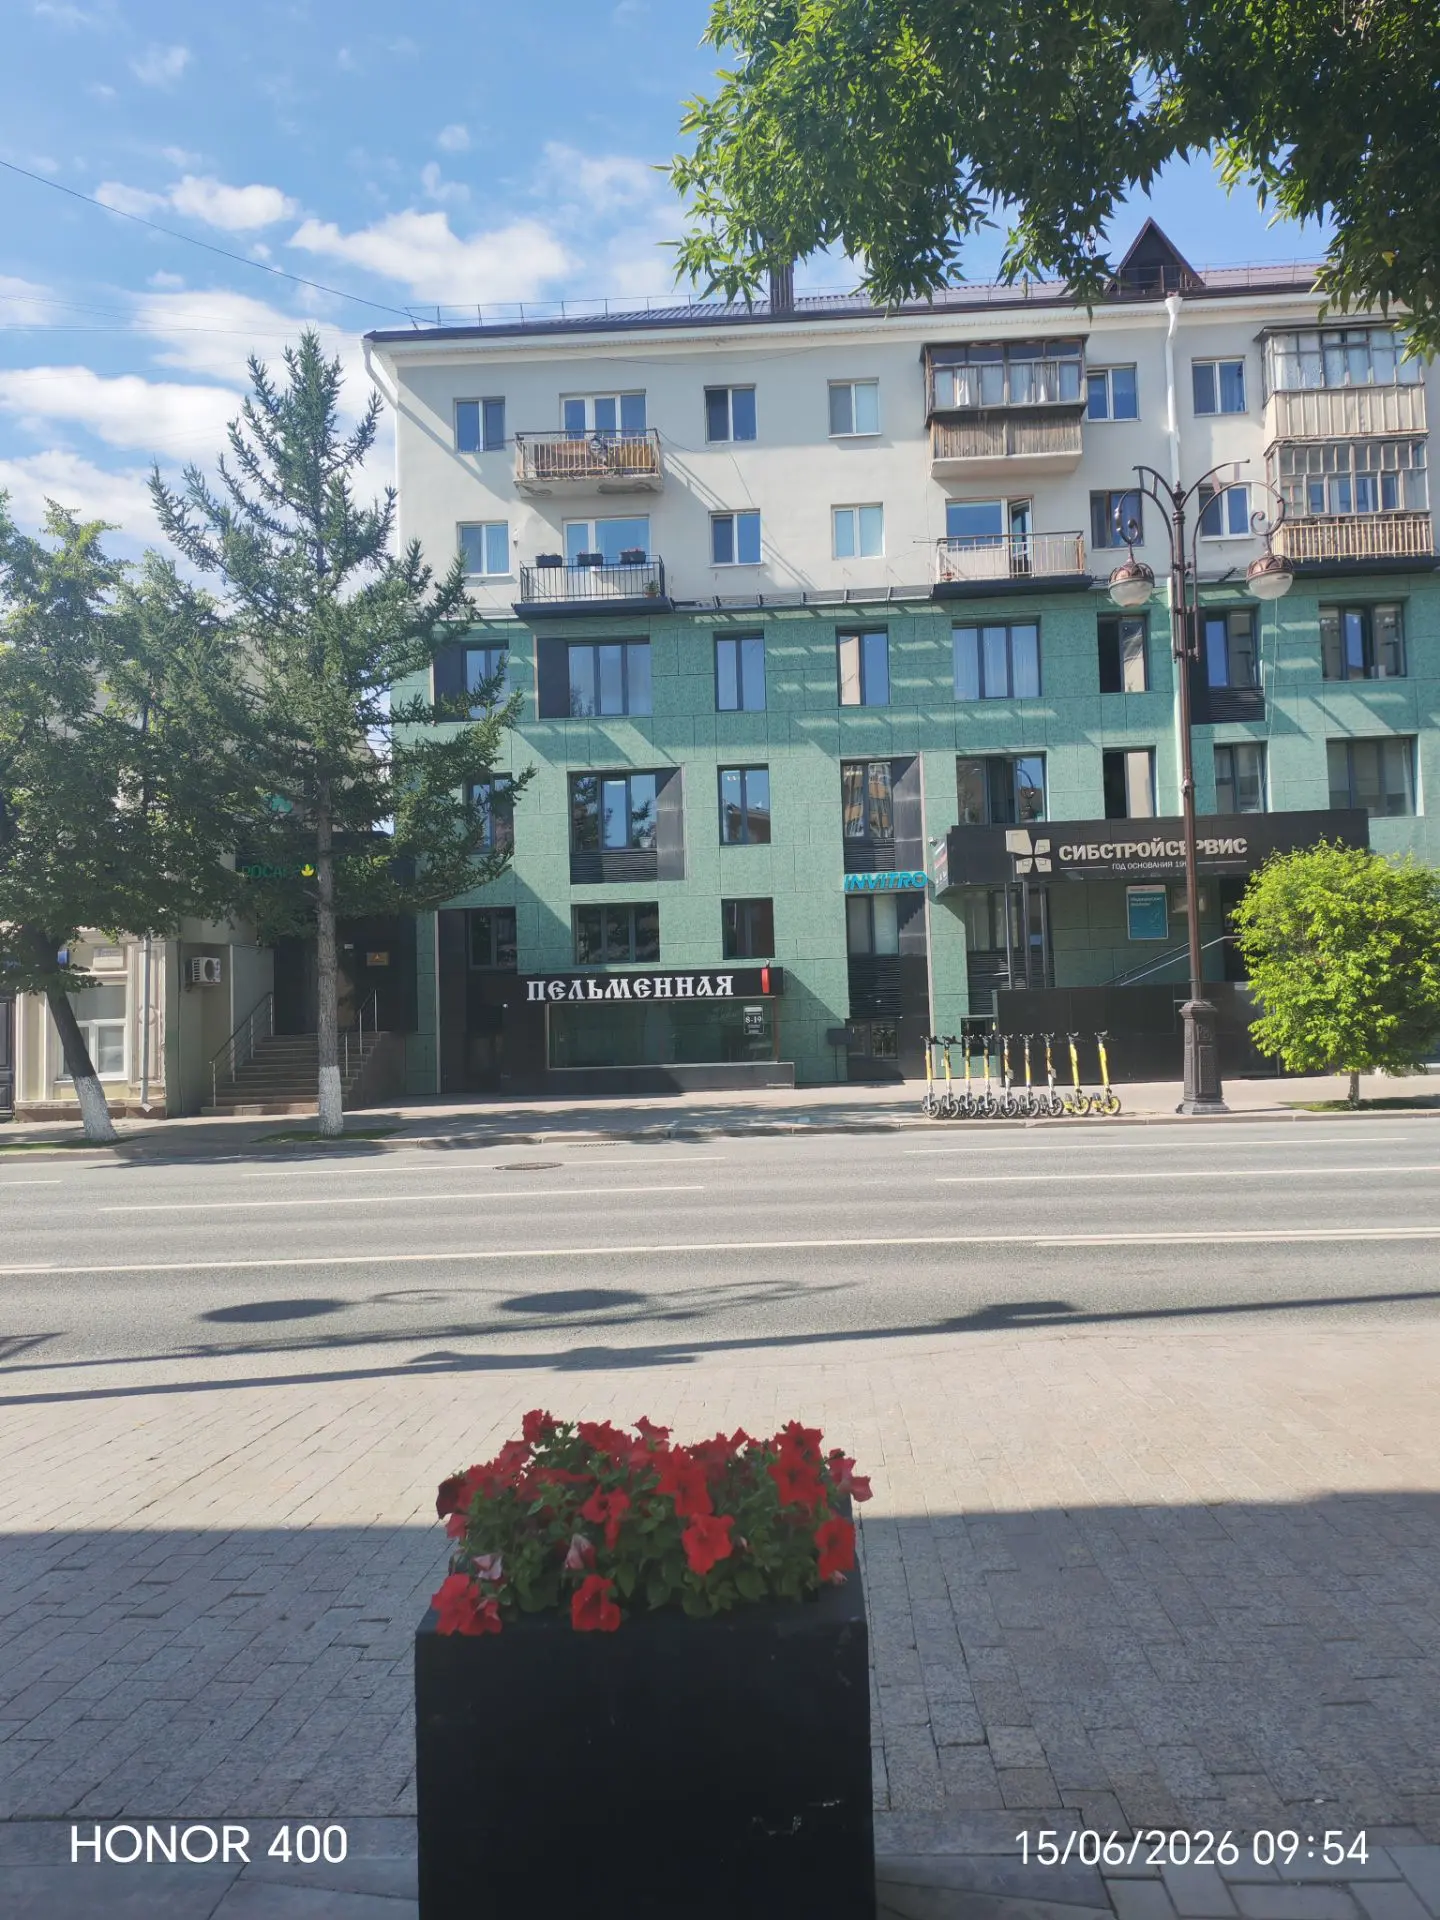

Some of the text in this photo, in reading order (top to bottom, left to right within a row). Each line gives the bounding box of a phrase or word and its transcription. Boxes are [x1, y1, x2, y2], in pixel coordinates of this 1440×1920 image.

[1112, 862, 1126, 871] ГОД
[1127, 861, 1173, 870] ОСНОВАНИЯ
[844, 872, 928, 891] INVITRO
[526, 975, 734, 1001] ПЕЛЬМЕННАЯ
